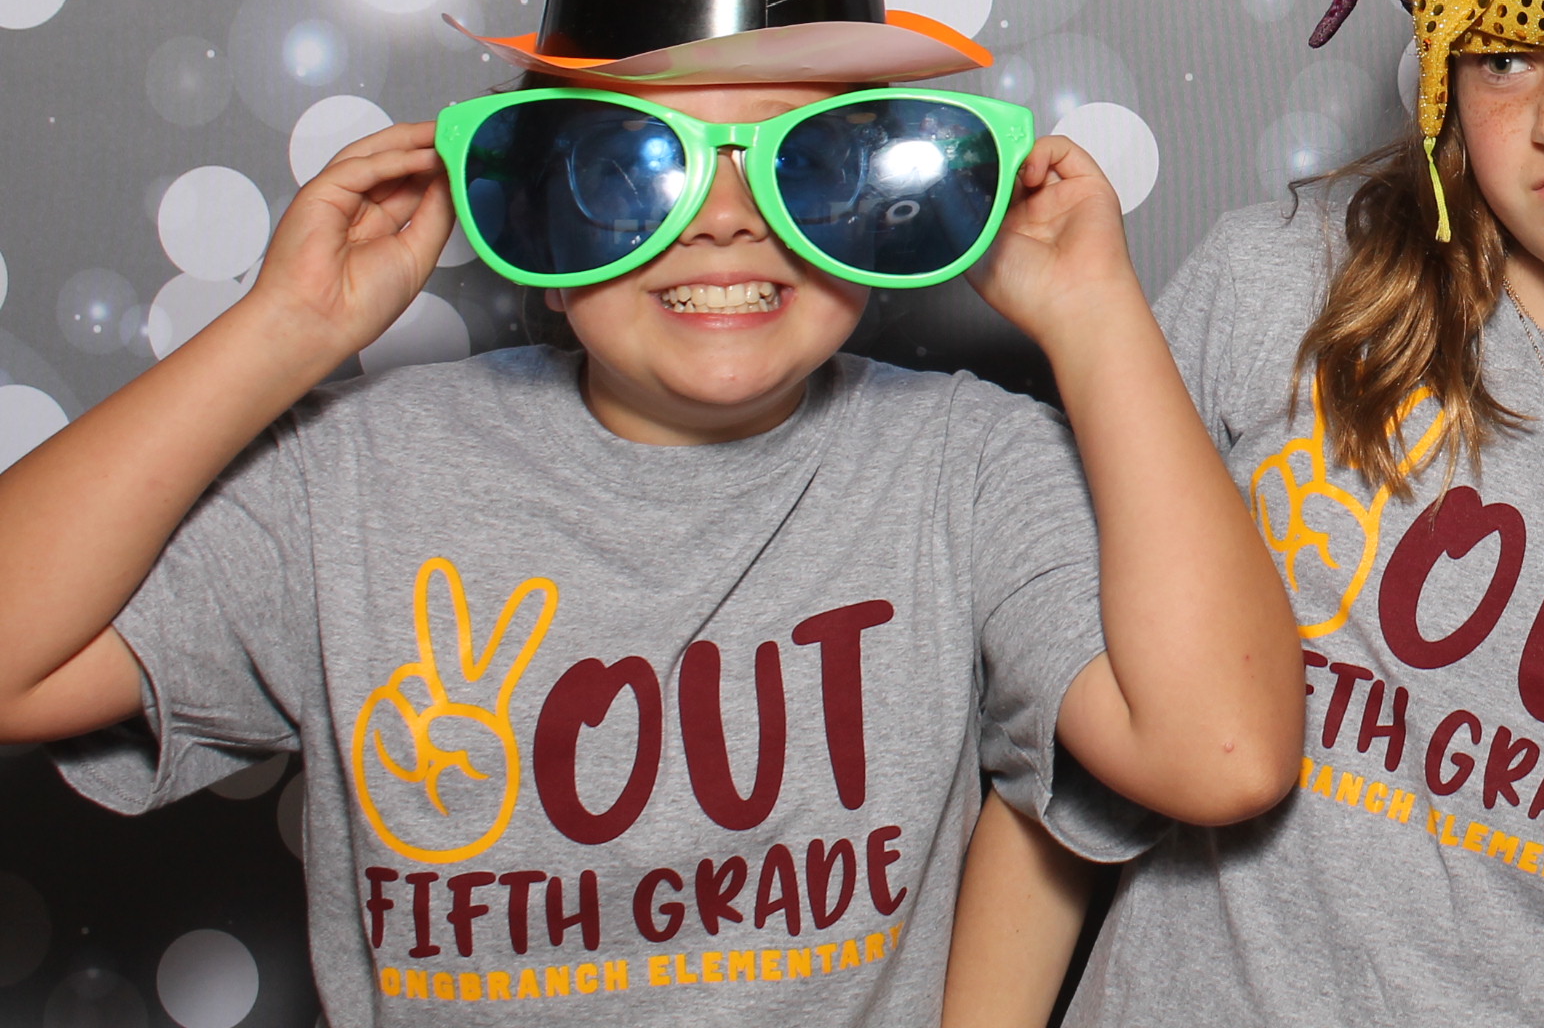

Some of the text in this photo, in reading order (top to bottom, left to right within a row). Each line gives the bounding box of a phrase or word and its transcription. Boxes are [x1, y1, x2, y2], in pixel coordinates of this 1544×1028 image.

[533, 599, 894, 845] OUT
[365, 825, 907, 959] FIFTH GRADE
[379, 922, 904, 1001] ONGBRANCH ELEMENTARY
